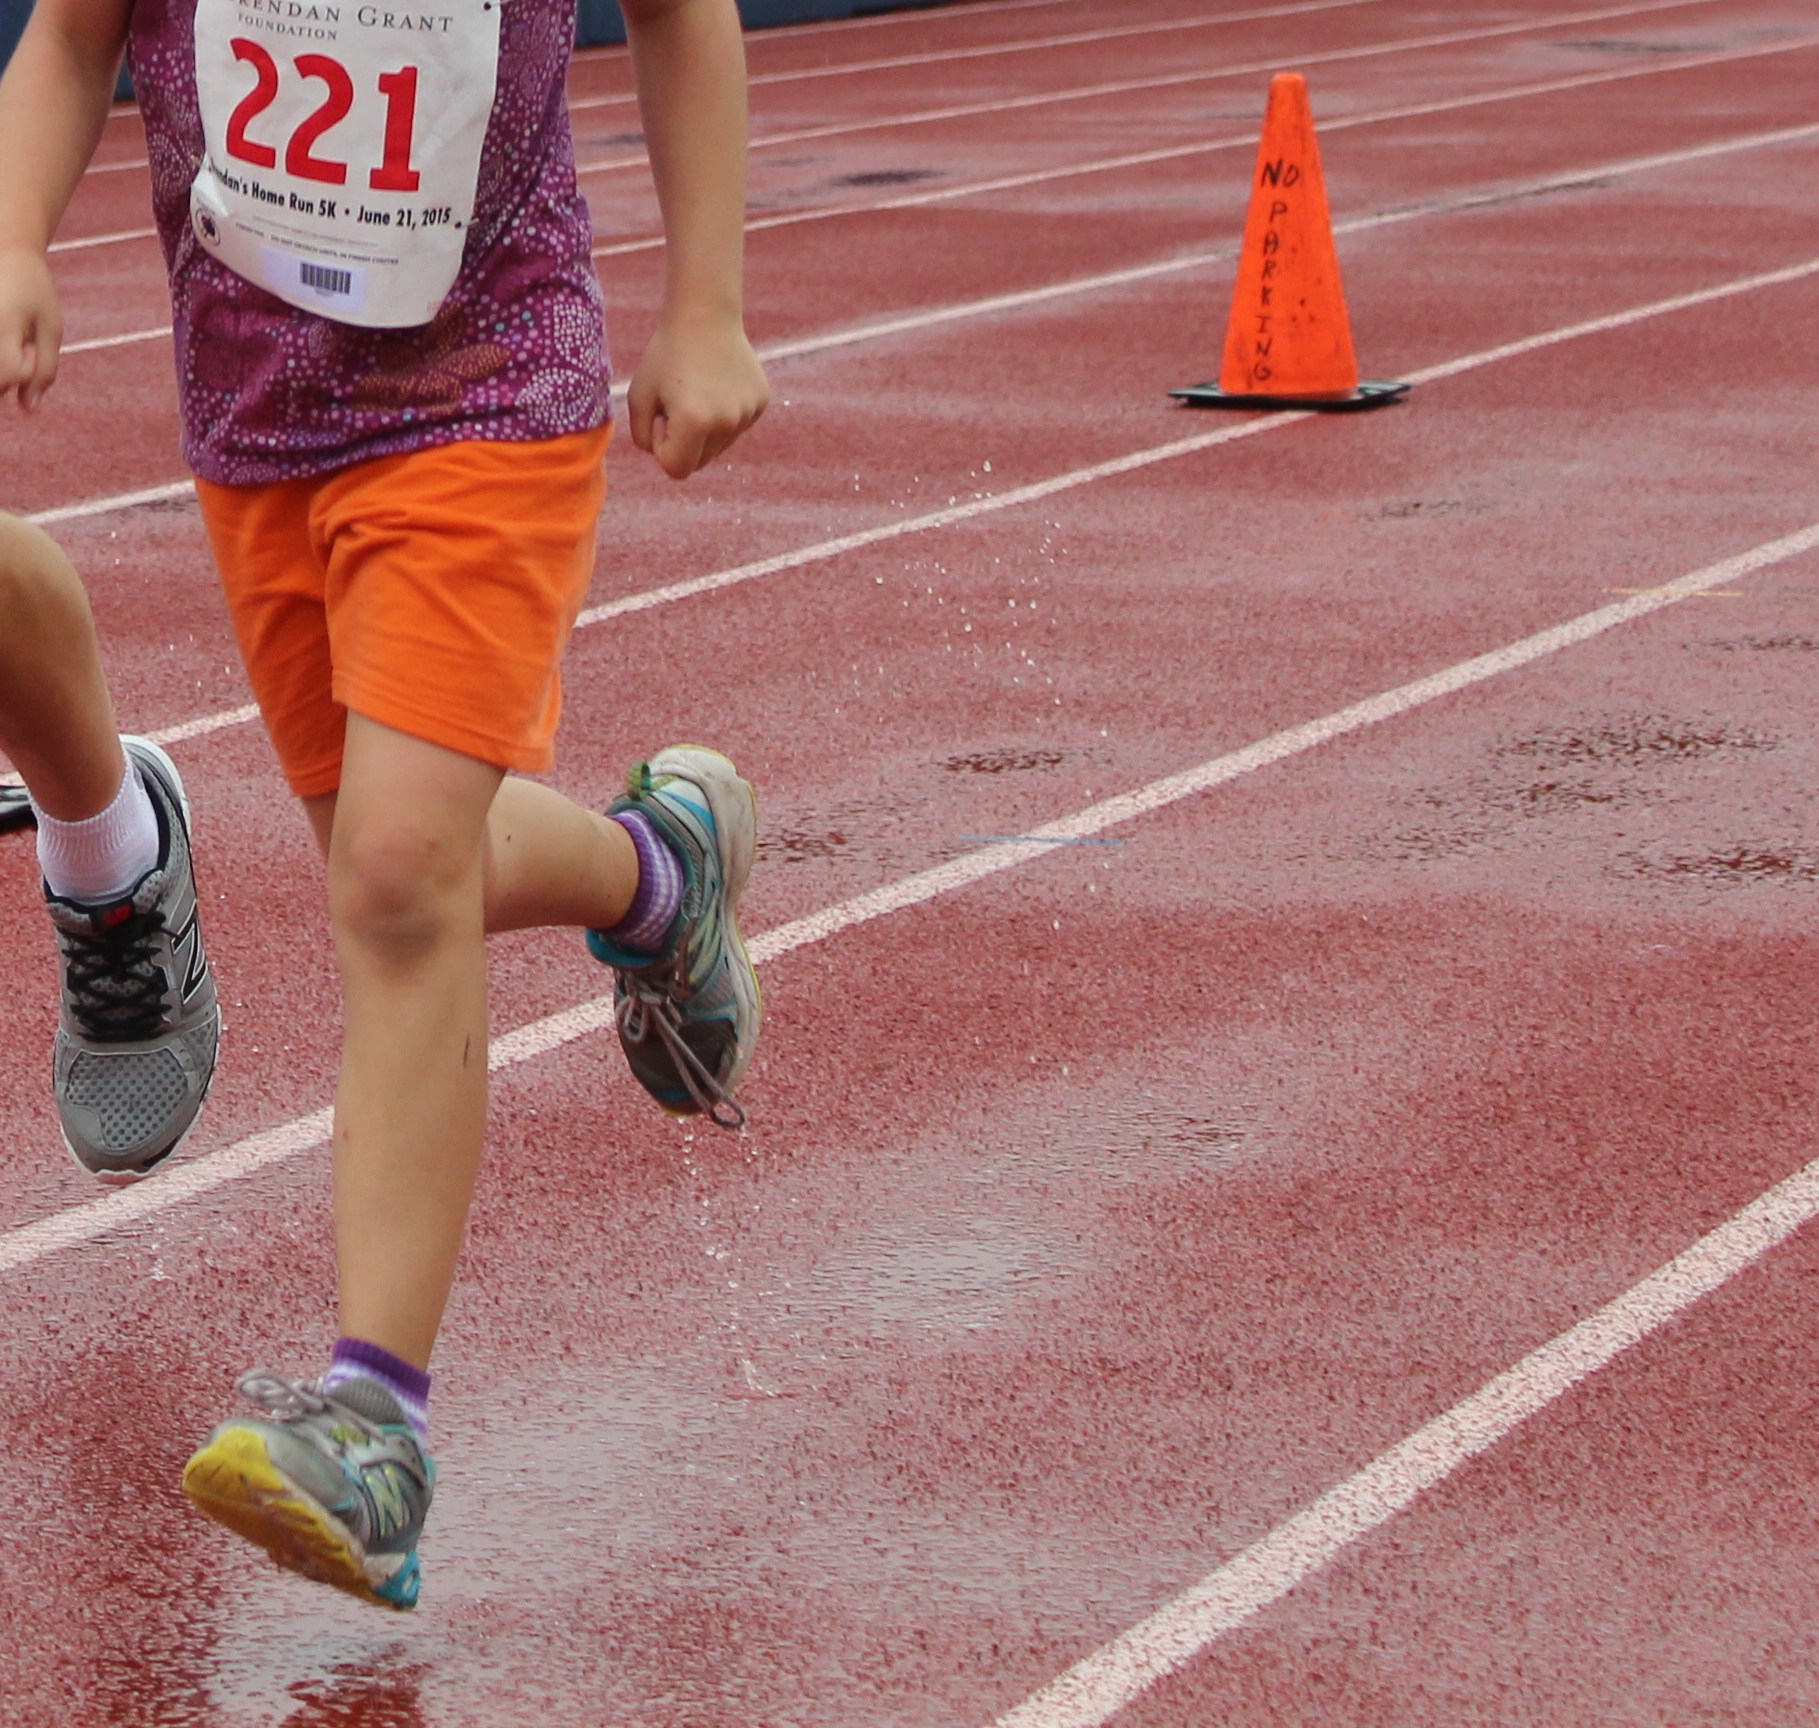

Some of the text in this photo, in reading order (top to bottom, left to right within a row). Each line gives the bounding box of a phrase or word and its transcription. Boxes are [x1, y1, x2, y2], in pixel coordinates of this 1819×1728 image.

[237, 13, 338, 41] FOUNDATION
[357, 5, 454, 33] GRANT
[225, 37, 420, 192] 221
[1260, 158, 1300, 188] NO
[251, 181, 285, 207] Home
[289, 192, 314, 214] Run
[318, 199, 337, 220] 5K
[356, 204, 390, 226] June
[396, 209, 417, 231] 21,
[422, 207, 451, 227] 2015
[1253, 201, 1288, 382] PARKING
